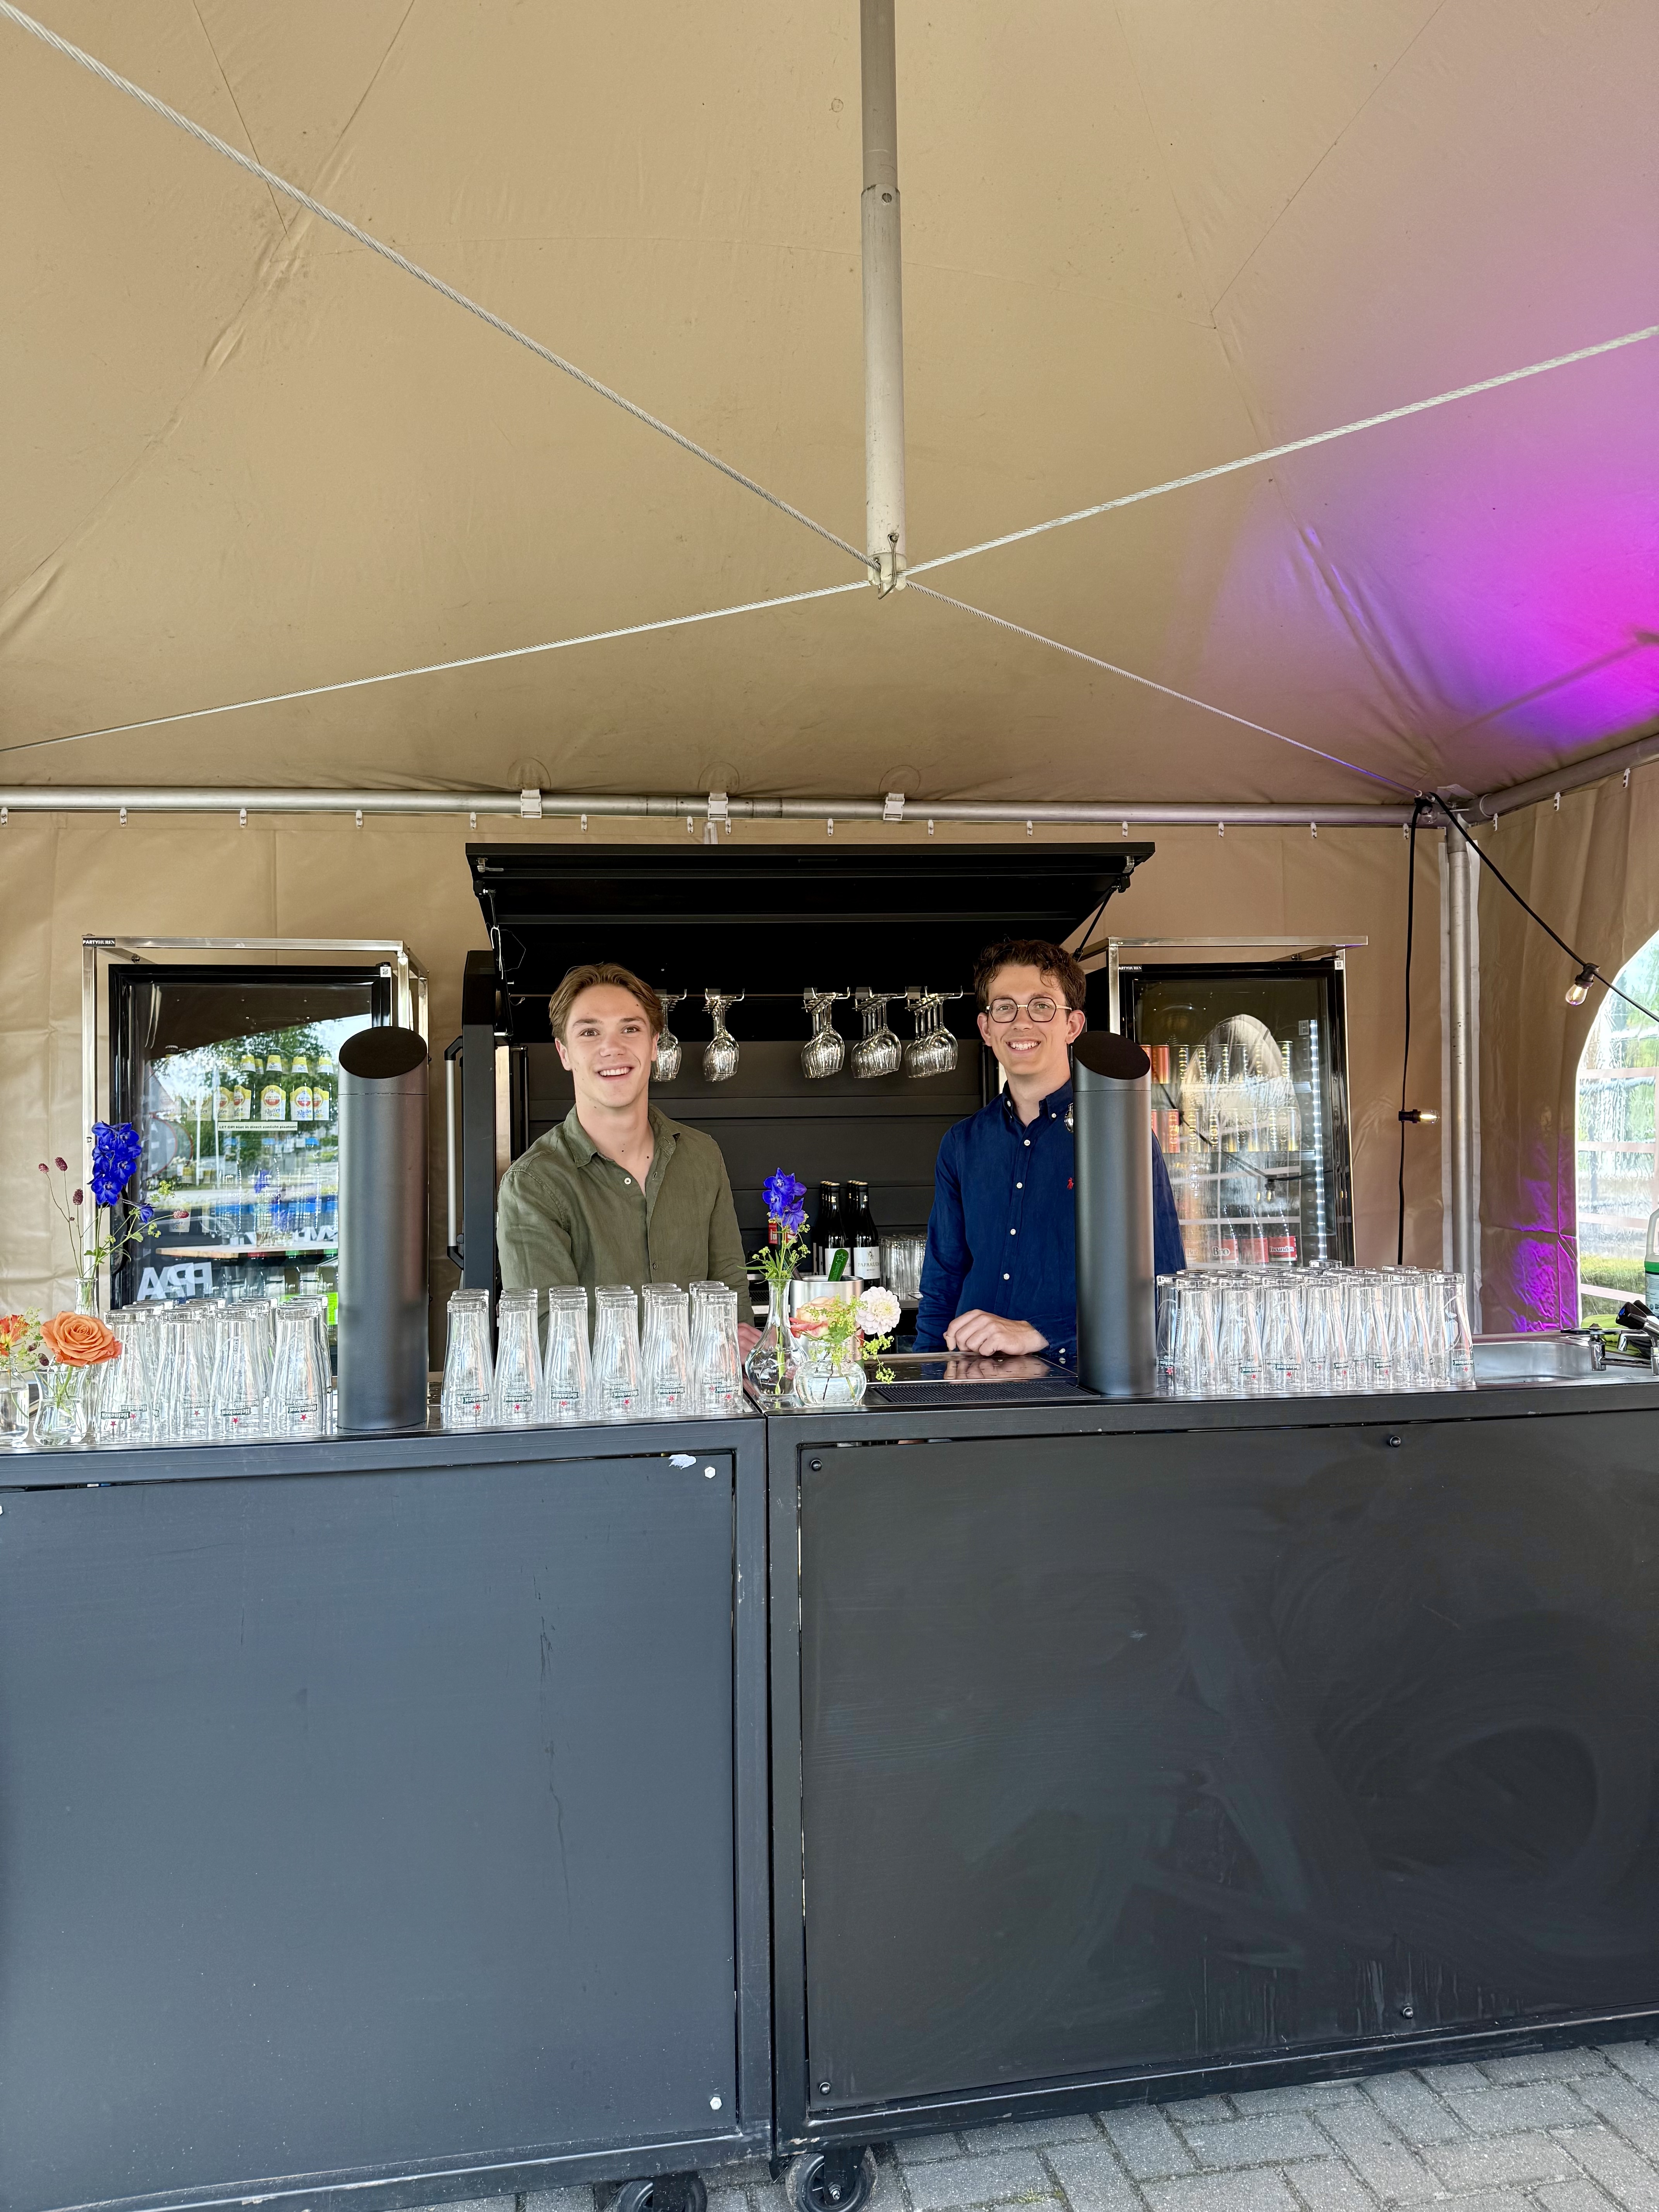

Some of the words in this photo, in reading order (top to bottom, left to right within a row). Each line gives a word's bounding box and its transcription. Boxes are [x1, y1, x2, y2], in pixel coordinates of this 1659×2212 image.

[1179, 1049, 1187, 1080] GOLD
[1199, 1050, 1207, 1080] GOLD
[1282, 1046, 1290, 1077] GOLD
[1209, 1114, 1219, 1145] GOLD
[1212, 1246, 1230, 1256] Bro
